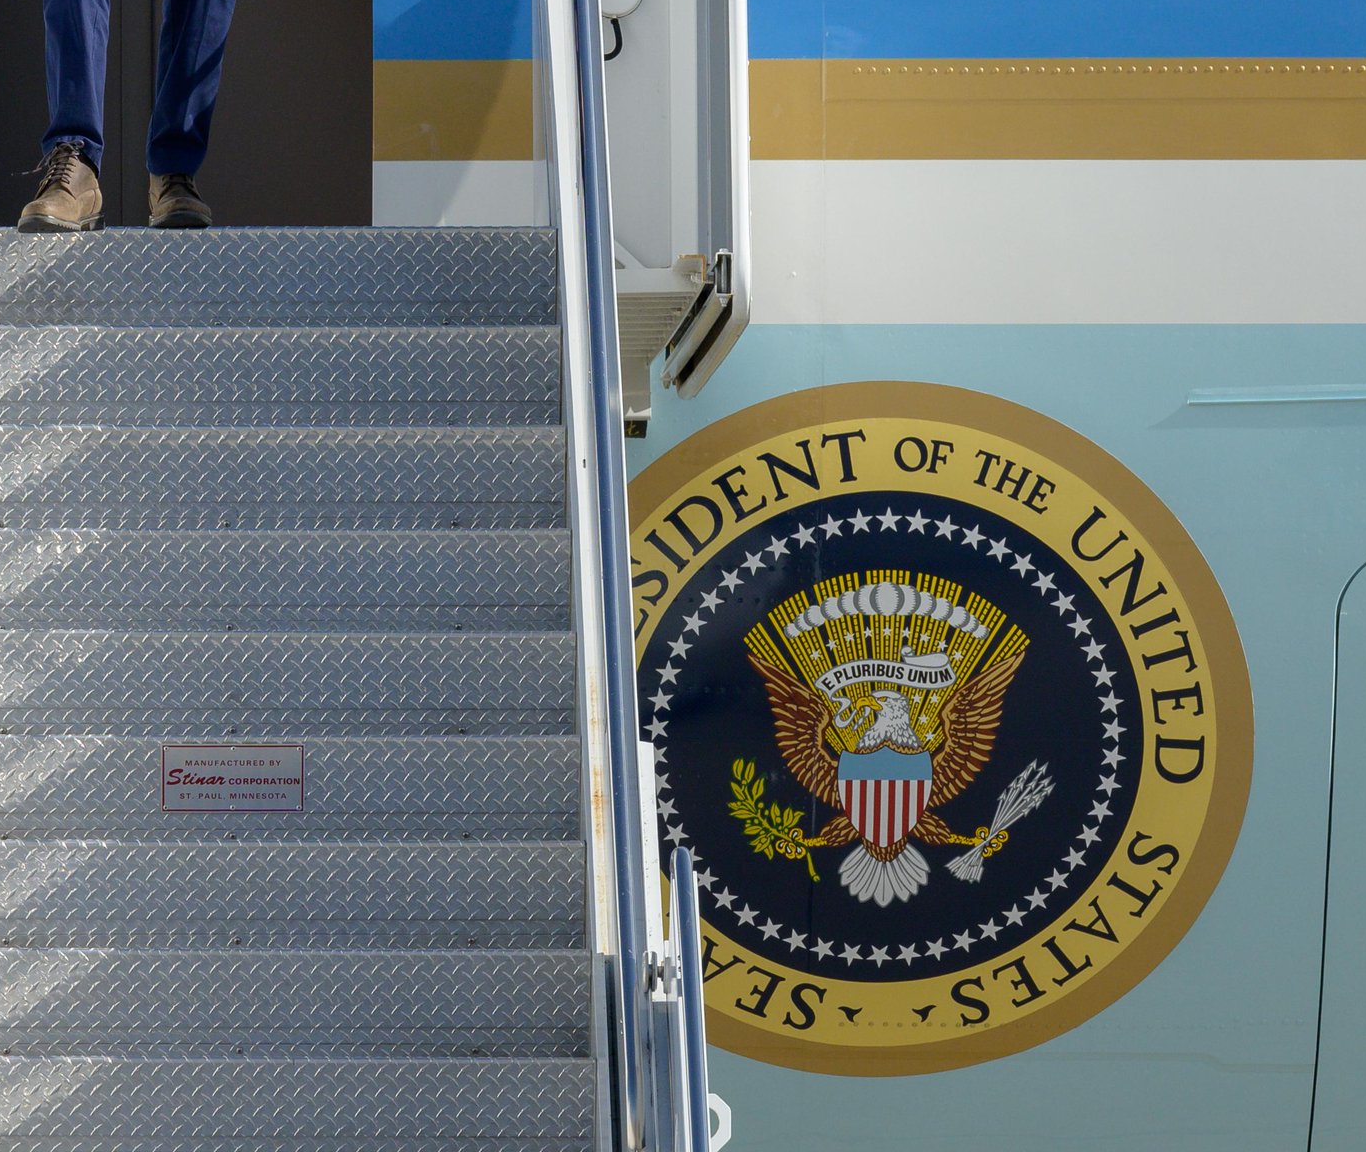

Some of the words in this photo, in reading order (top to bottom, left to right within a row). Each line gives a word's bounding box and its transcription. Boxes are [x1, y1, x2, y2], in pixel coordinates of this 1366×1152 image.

[894, 436, 954, 474] OF
[974, 449, 1056, 515] THE
[632, 429, 867, 641] SIDENT
[1072, 506, 1206, 785] UNITED
[821, 677, 835, 691] E
[834, 663, 905, 684] PLURIBUS
[907, 668, 953, 685] UNUM
[166, 768, 226, 786] Stinar
[228, 777, 300, 785] CORPORATION
[185, 759, 265, 767] MANUFACTURED
[269, 759, 282, 767] BY
[179, 792, 193, 800] ST.
[198, 792, 226, 801] PAUL,
[229, 792, 287, 800] MINNESOTA
[951, 830, 1181, 1027] STATES
[702, 935, 828, 1031] SEA
